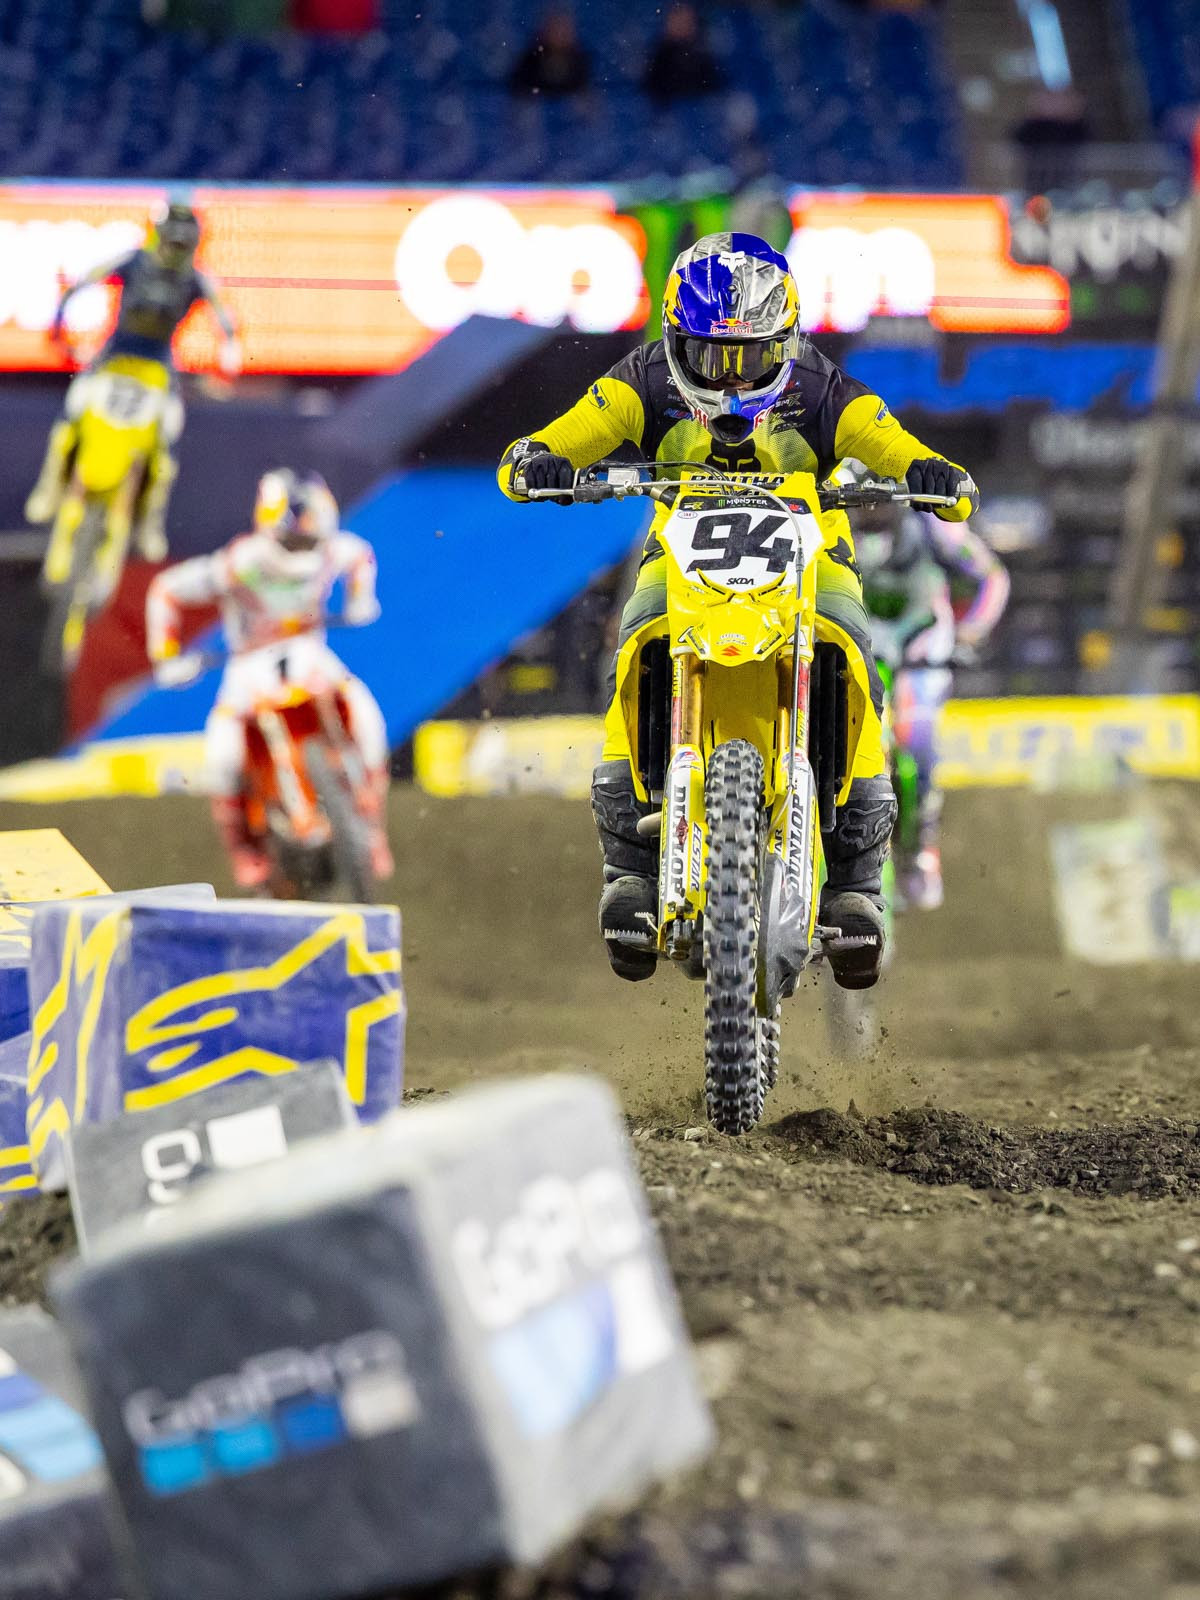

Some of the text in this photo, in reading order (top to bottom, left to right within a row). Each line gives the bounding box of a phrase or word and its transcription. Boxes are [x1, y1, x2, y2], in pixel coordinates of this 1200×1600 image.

[726, 497, 768, 506] MONSTER
[686, 513, 796, 573] 94
[726, 578, 755, 586] SKDA
[690, 822, 702, 893] ECSTAR
